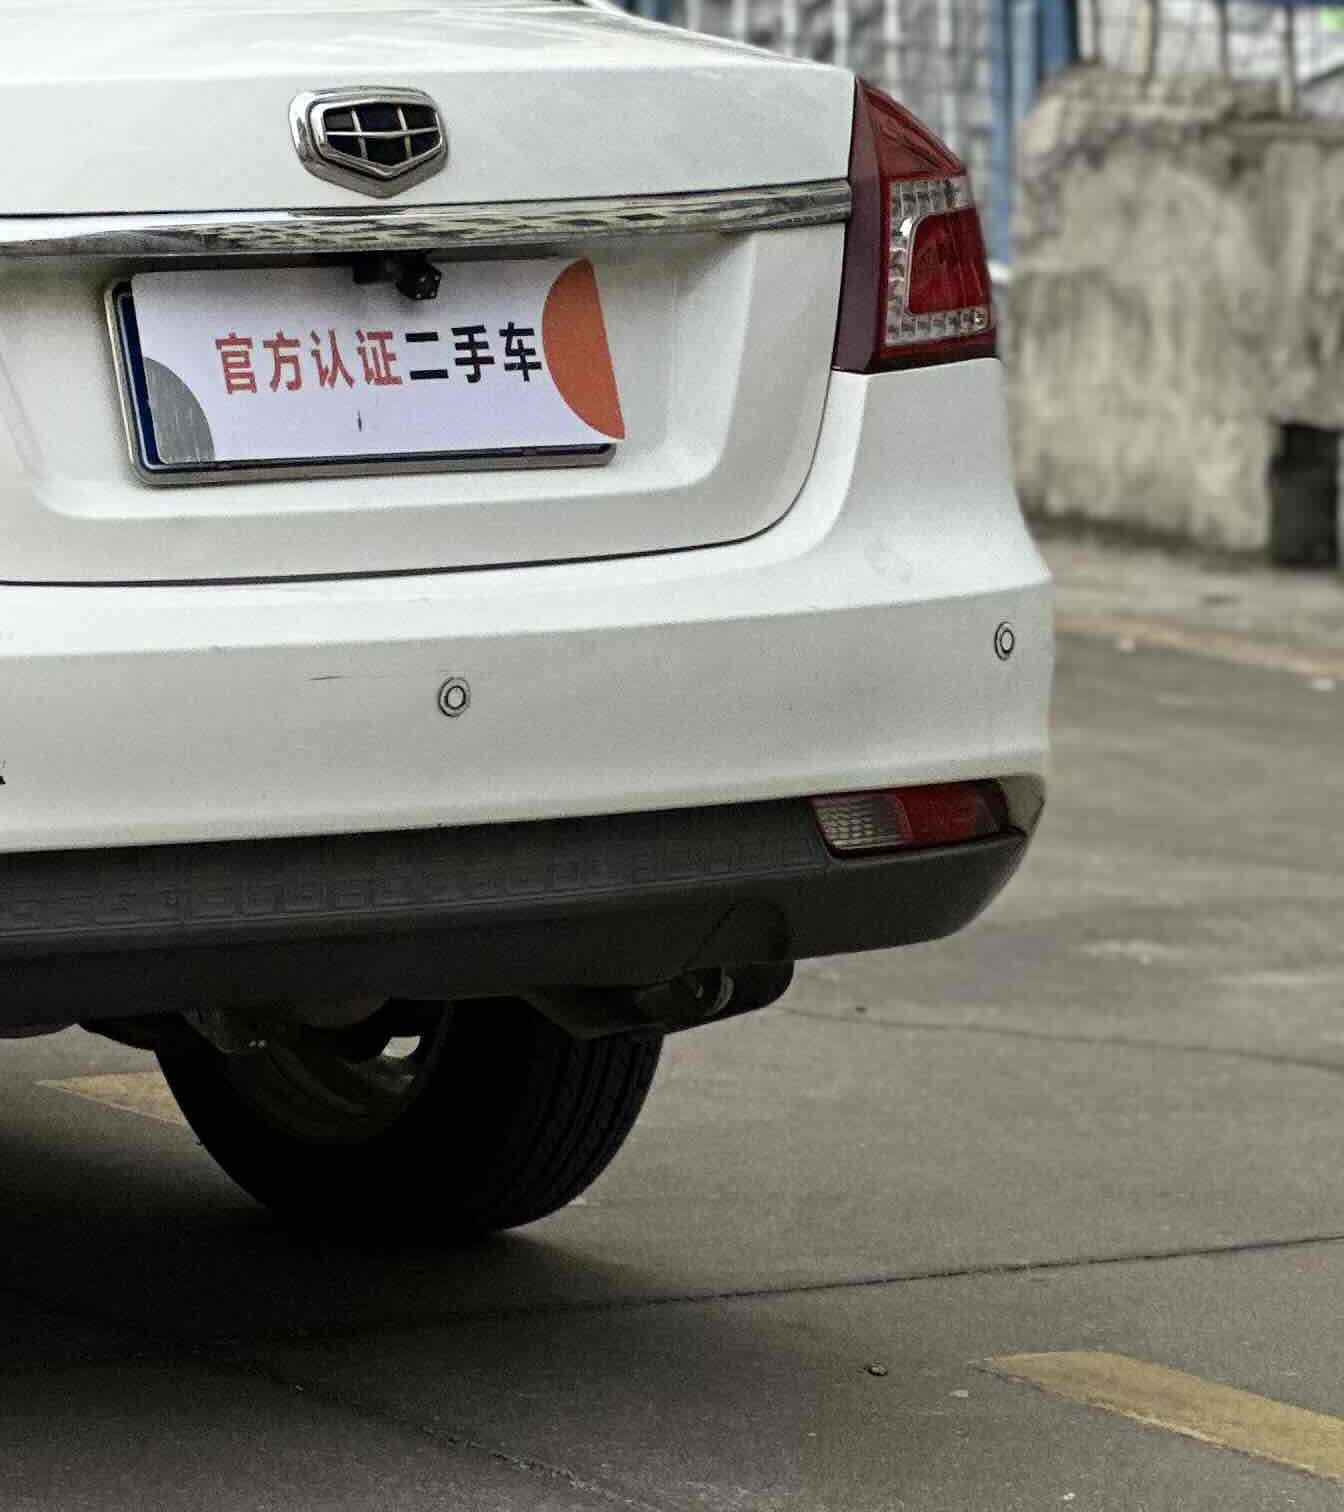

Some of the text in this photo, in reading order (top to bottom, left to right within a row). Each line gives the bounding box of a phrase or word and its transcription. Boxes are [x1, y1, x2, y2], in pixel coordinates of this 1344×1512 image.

[215, 321, 543, 394] 官方认证二手车
